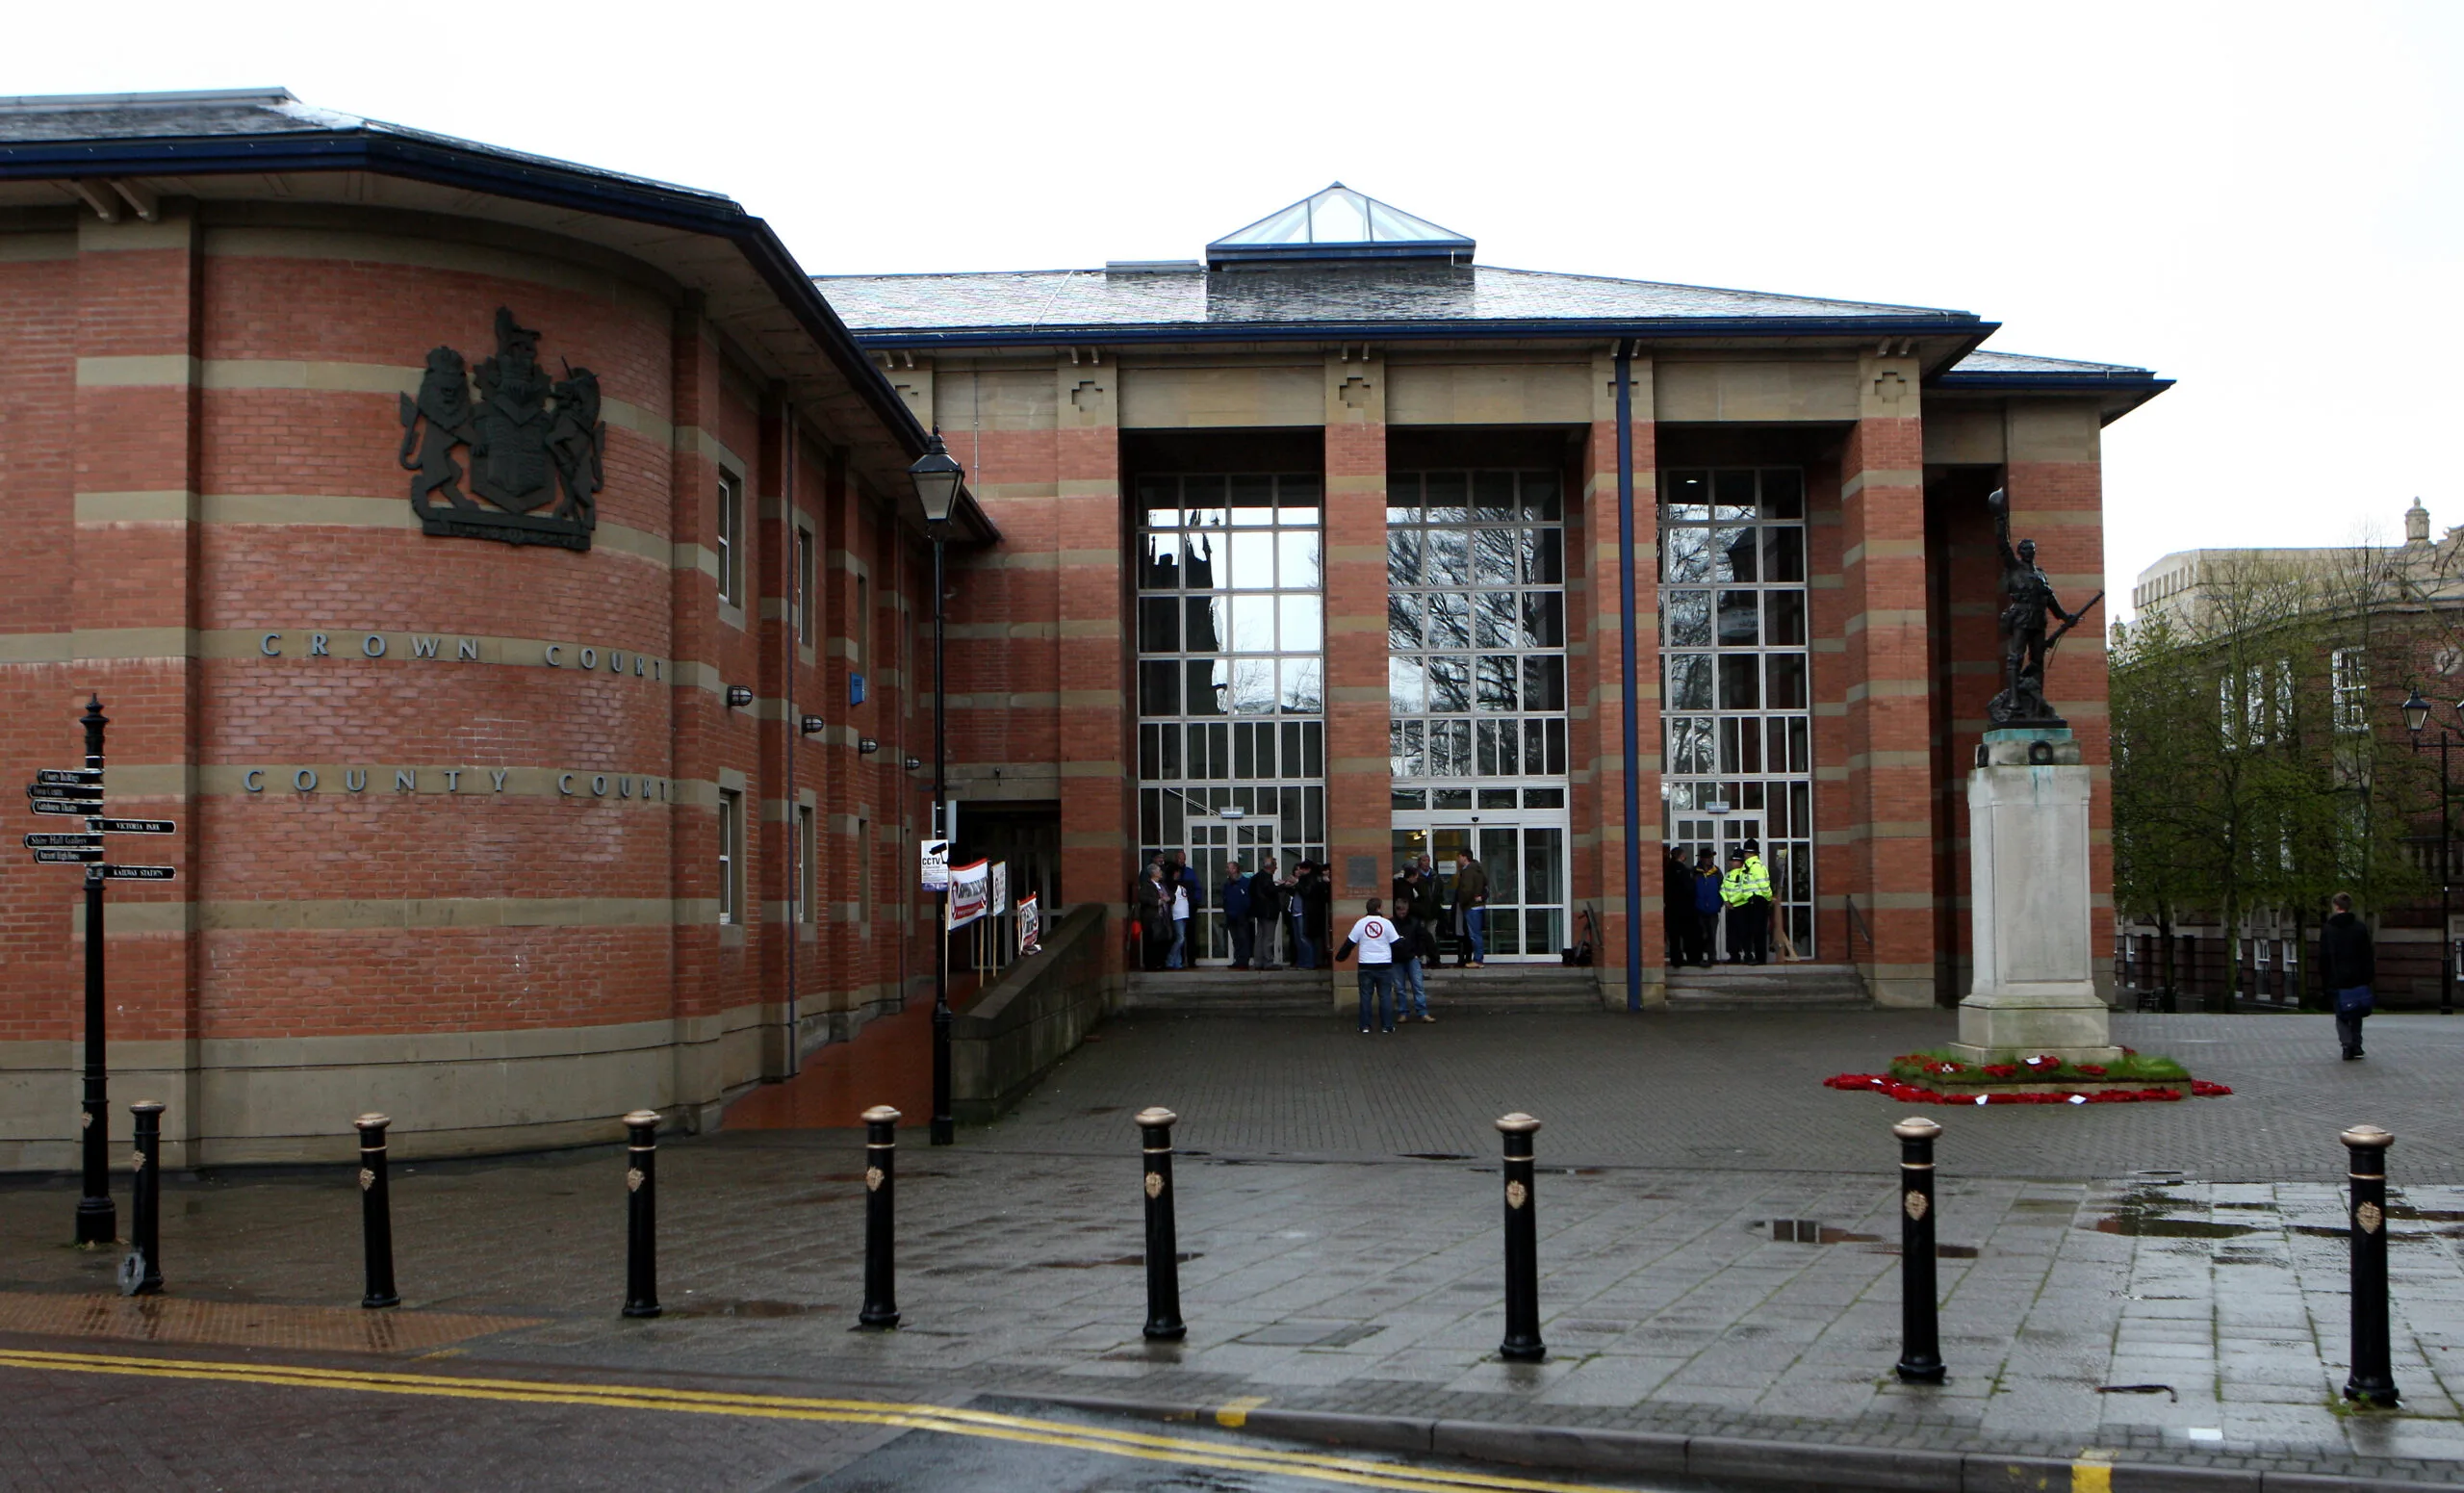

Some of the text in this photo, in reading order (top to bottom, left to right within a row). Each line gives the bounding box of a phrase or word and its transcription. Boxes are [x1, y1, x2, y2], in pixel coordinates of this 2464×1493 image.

[260, 633, 664, 681] CROWN COURT
[243, 769, 668, 801] COUNTY COURT
[49, 836, 64, 844] Hall
[64, 836, 88, 845] Gallery
[922, 857, 940, 865] CCTV
